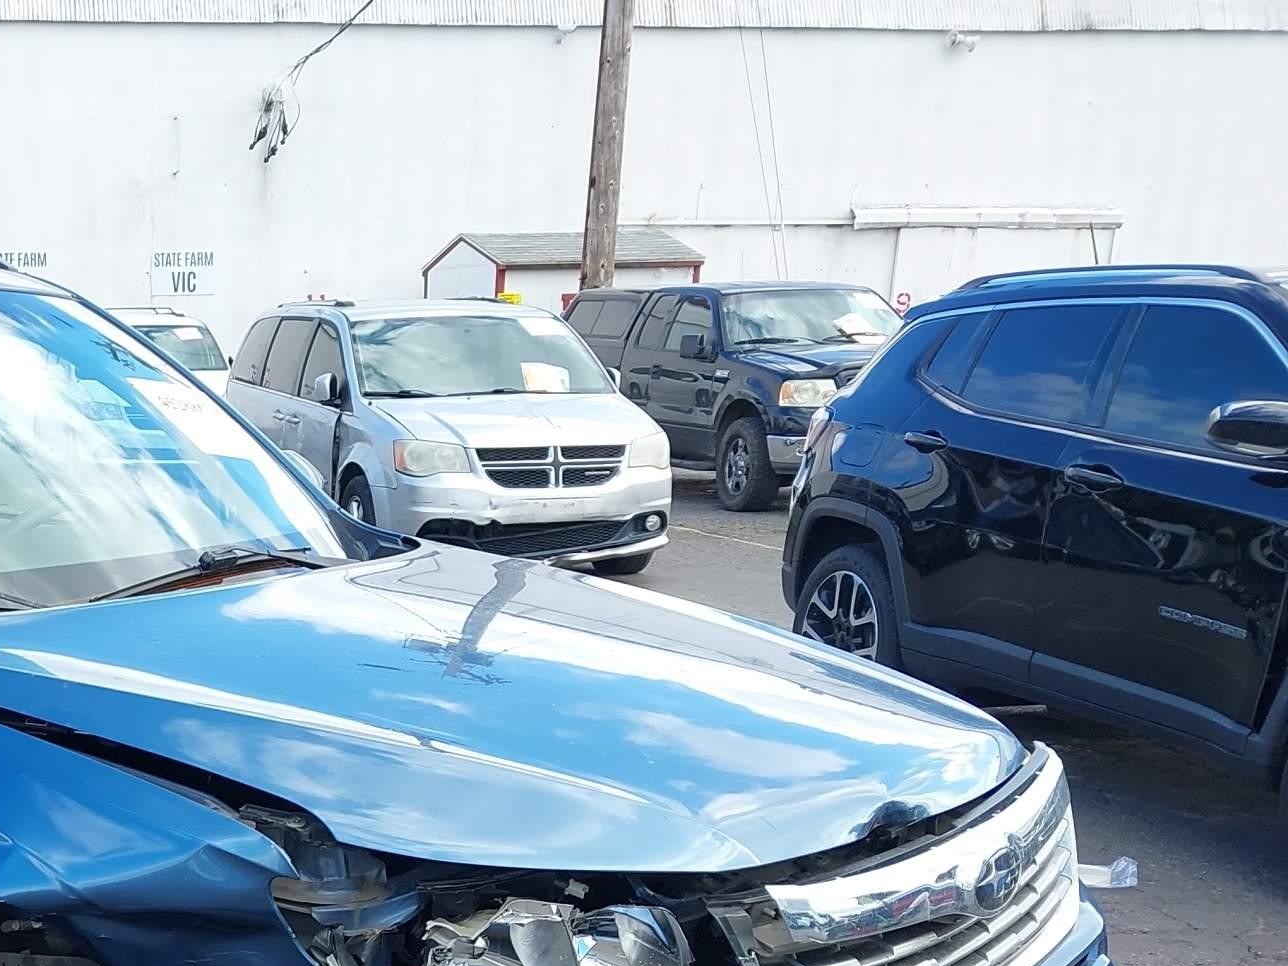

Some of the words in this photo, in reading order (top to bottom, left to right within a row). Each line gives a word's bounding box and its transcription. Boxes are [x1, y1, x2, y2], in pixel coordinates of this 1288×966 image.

[17, 252, 48, 268] FARM
[154, 252, 183, 268] STATE
[185, 251, 214, 268] FARM
[171, 271, 197, 293] VIC
[896, 292, 911, 314] 9
